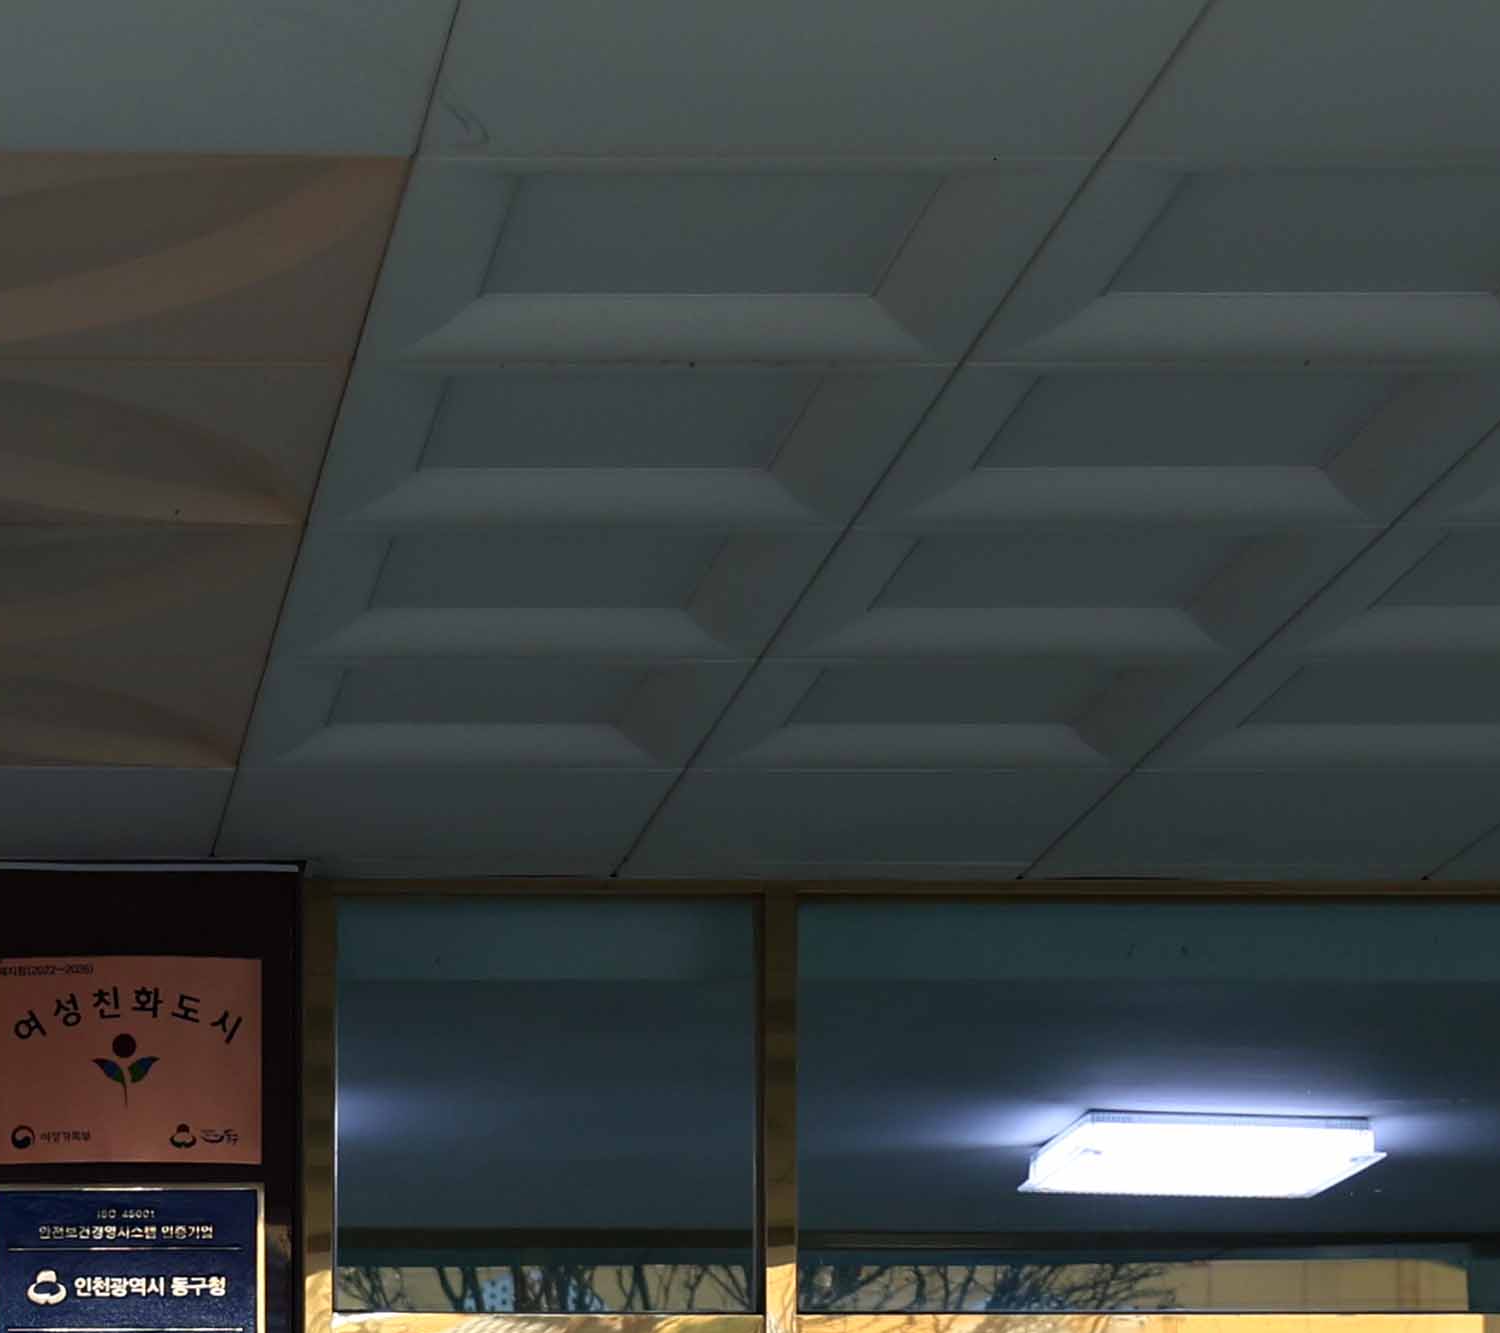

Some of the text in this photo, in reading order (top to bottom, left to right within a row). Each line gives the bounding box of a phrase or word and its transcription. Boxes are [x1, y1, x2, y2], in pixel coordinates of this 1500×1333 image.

[13, 986, 243, 1045] 여성친화도시
[73, 1276, 227, 1298] 인천광역시 동구청
